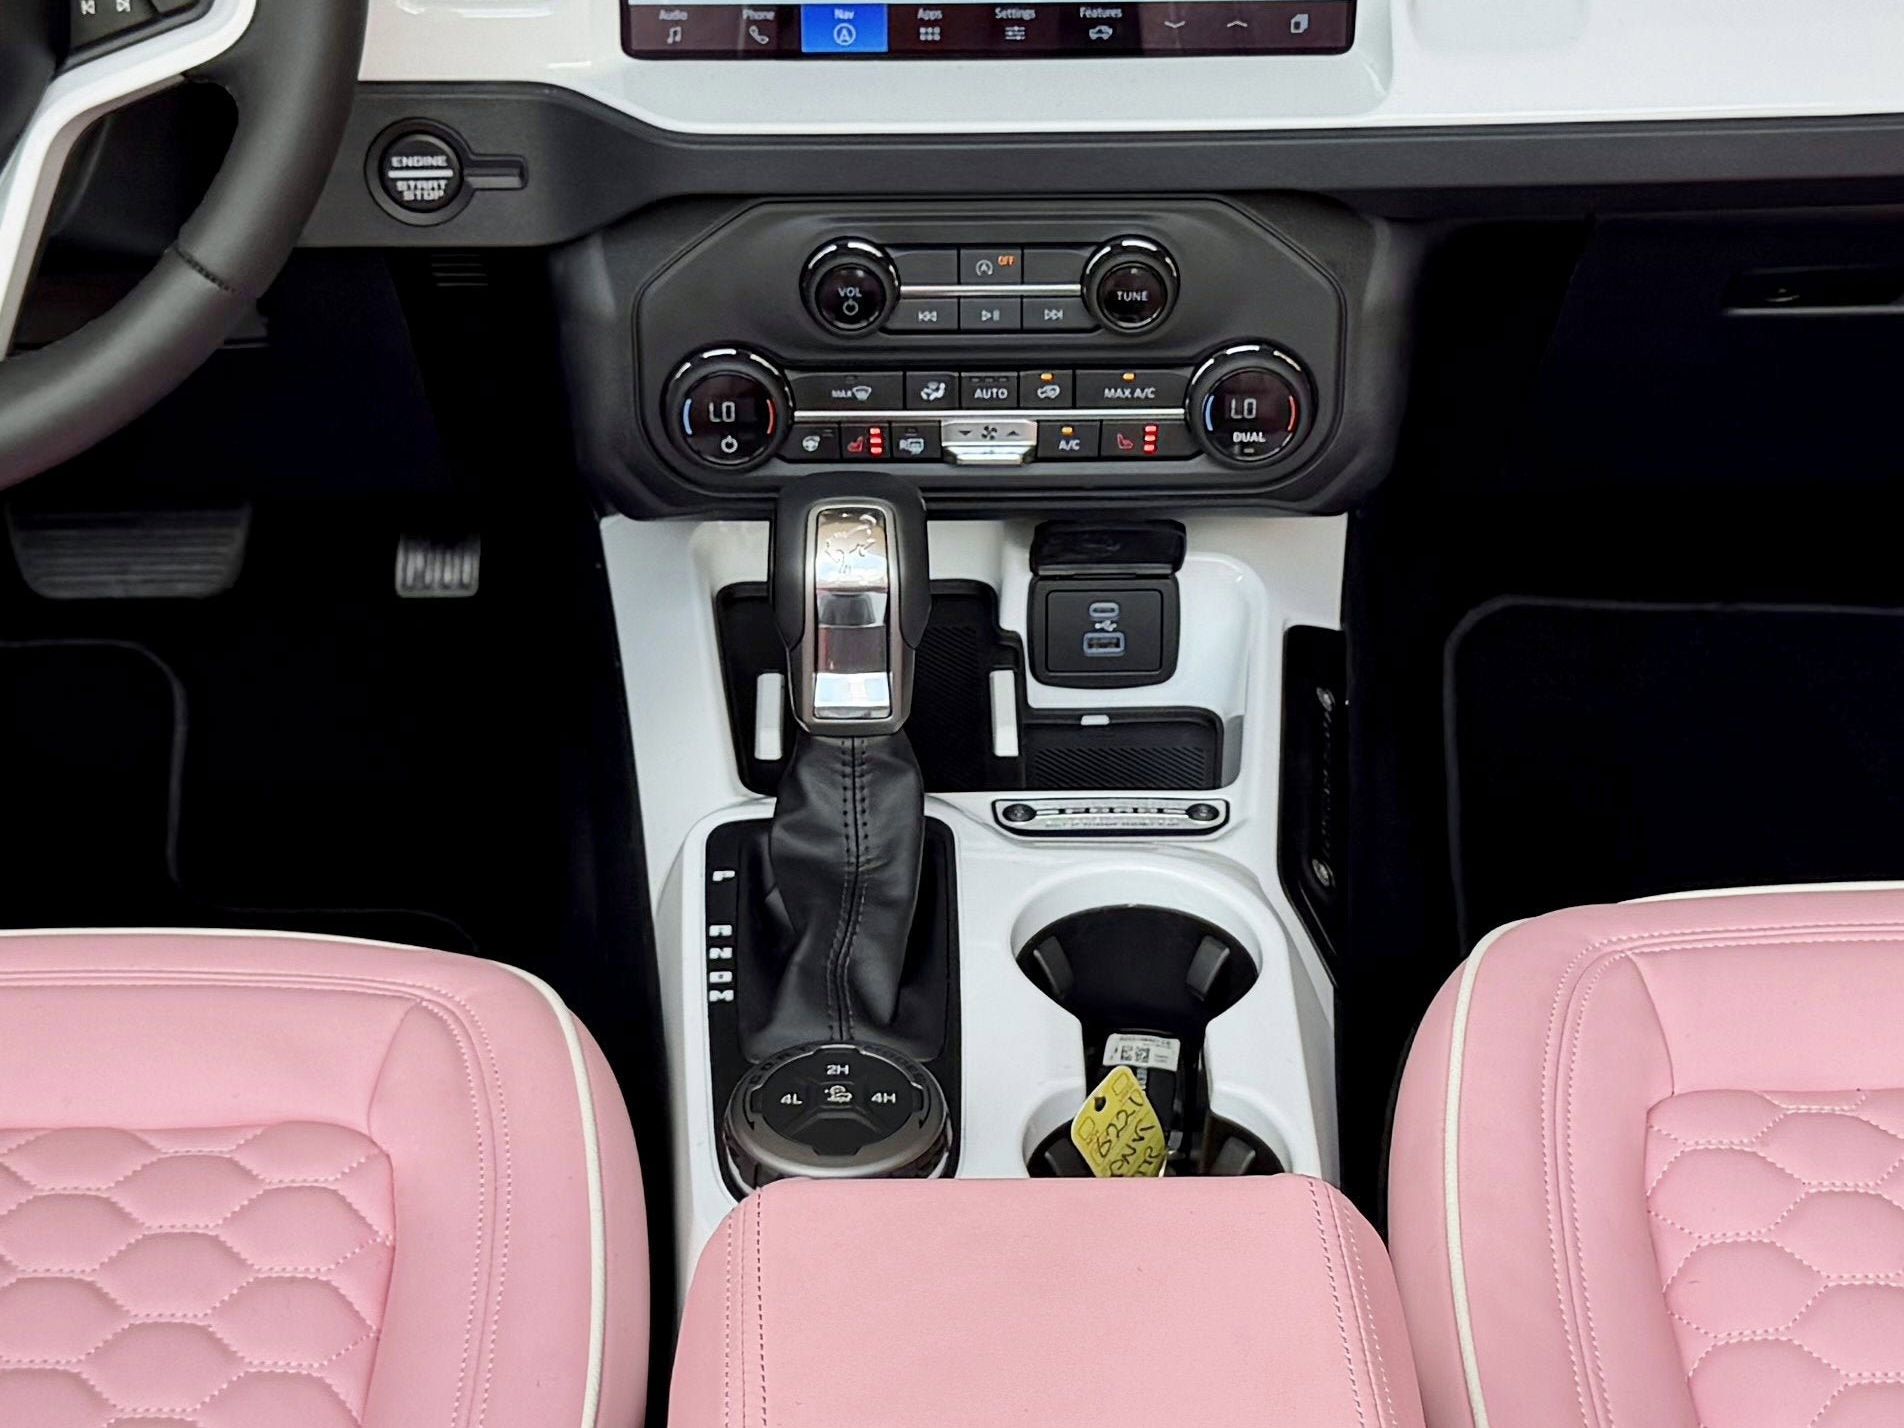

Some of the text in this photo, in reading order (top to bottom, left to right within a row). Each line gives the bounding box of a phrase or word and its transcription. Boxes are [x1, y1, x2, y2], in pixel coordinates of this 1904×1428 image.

[659, 9, 688, 21] Audio
[743, 8, 775, 21] Phone
[835, 8, 854, 20] Nav
[917, 8, 943, 21] Apps
[995, 7, 1036, 21] Settings
[1080, 7, 1123, 19] Features
[391, 155, 449, 168] ENGINE
[396, 179, 448, 192] START
[403, 190, 445, 202] STOP
[998, 256, 1016, 267] OFF
[838, 287, 862, 298] VOL
[1116, 290, 1148, 301] TUNE
[974, 388, 1008, 399] AUTO
[1104, 387, 1156, 399] MAX A/C
[709, 401, 736, 422] LO
[1230, 398, 1257, 419] LO
[1233, 432, 1266, 443] DUAL
[1058, 438, 1080, 451] A/C
[712, 870, 736, 882] P
[709, 947, 733, 959] N
[709, 989, 734, 1002] M
[826, 1064, 849, 1075] 2H
[780, 1093, 803, 1105] 4L
[871, 1092, 896, 1104] 4H
